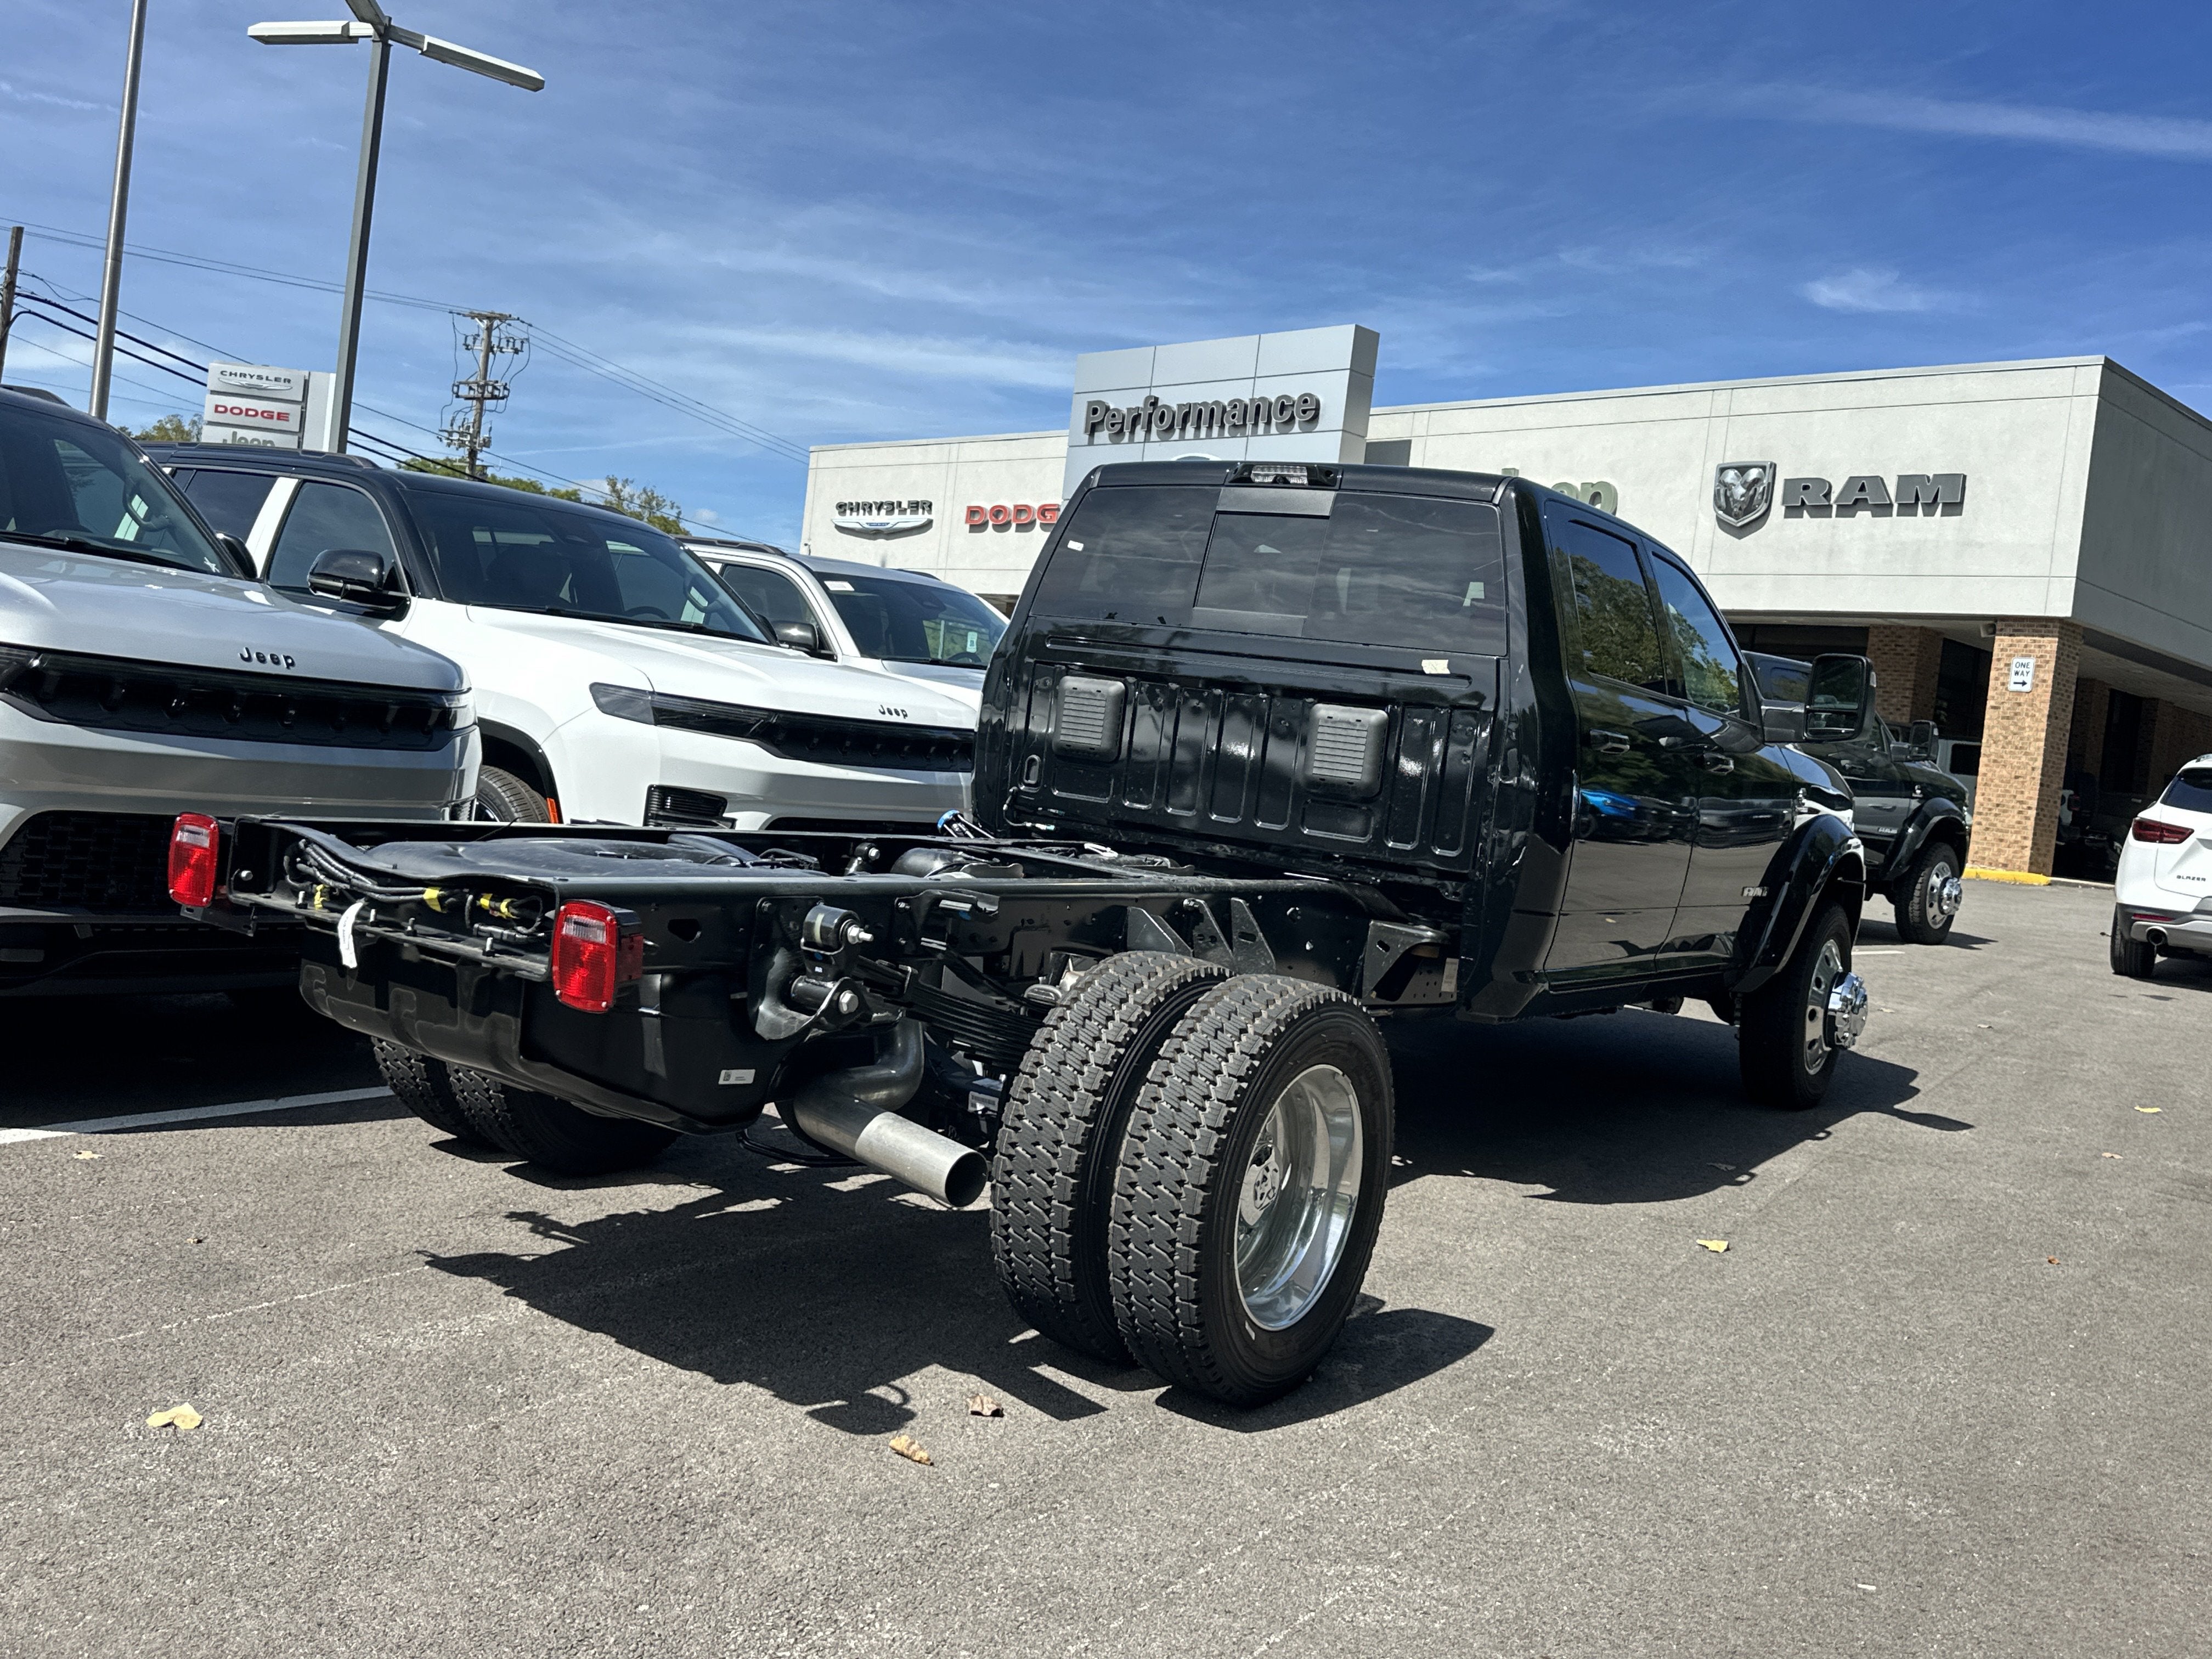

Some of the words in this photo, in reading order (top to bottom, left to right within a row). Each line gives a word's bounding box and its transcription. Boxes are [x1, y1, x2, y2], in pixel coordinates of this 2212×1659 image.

[220, 370, 292, 384] CHRYSLER
[214, 404, 290, 422] DODGE
[1084, 392, 1321, 436] Performance
[1781, 473, 1967, 507] RAM
[835, 499, 933, 514] CHRYSLER
[964, 503, 1061, 525] DODG
[238, 647, 296, 670] Jeep
[878, 704, 908, 719] Jeep
